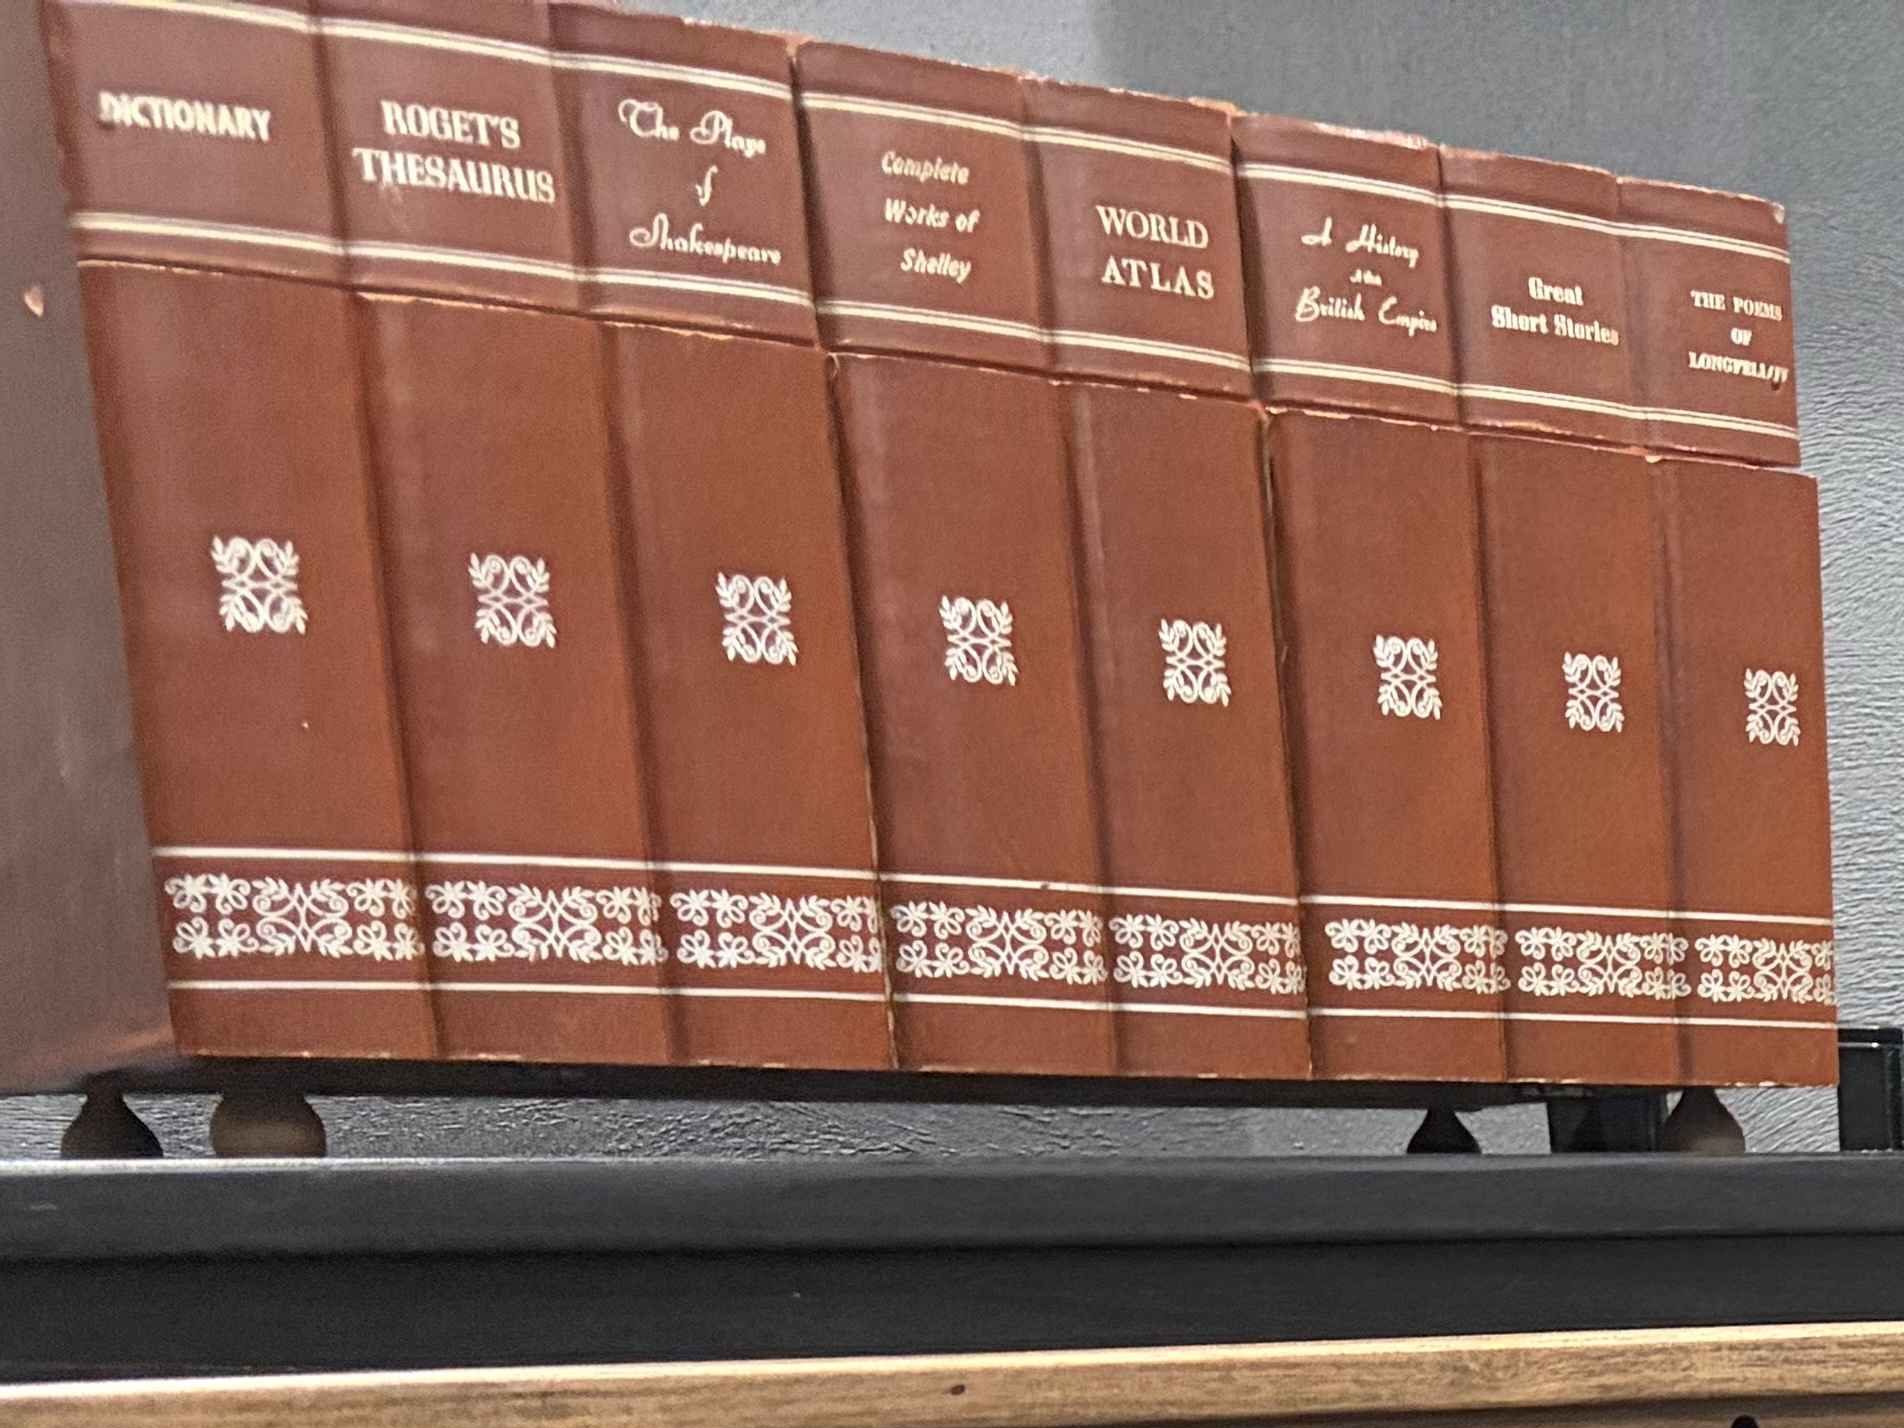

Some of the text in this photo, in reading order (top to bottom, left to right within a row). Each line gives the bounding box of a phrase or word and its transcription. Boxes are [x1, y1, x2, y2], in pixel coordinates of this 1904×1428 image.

[98, 90, 271, 142] DICTIONARY
[380, 99, 521, 149] ROGET'S
[618, 99, 767, 158] The Plays
[352, 147, 556, 204] THESAURUS
[881, 150, 970, 185] Complete
[884, 198, 981, 233] Works of
[1096, 205, 1209, 249] WORLD
[629, 213, 782, 266] Shakespeare
[1345, 223, 1420, 268] History
[900, 248, 971, 284] Shelley
[1102, 255, 1215, 300] ATLAS
[1295, 285, 1438, 337] British Empire
[1528, 276, 1585, 306] Great
[1690, 289, 1784, 322] THE POEMS
[1491, 304, 1620, 346] Short Stories
[1730, 327, 1753, 346] OF
